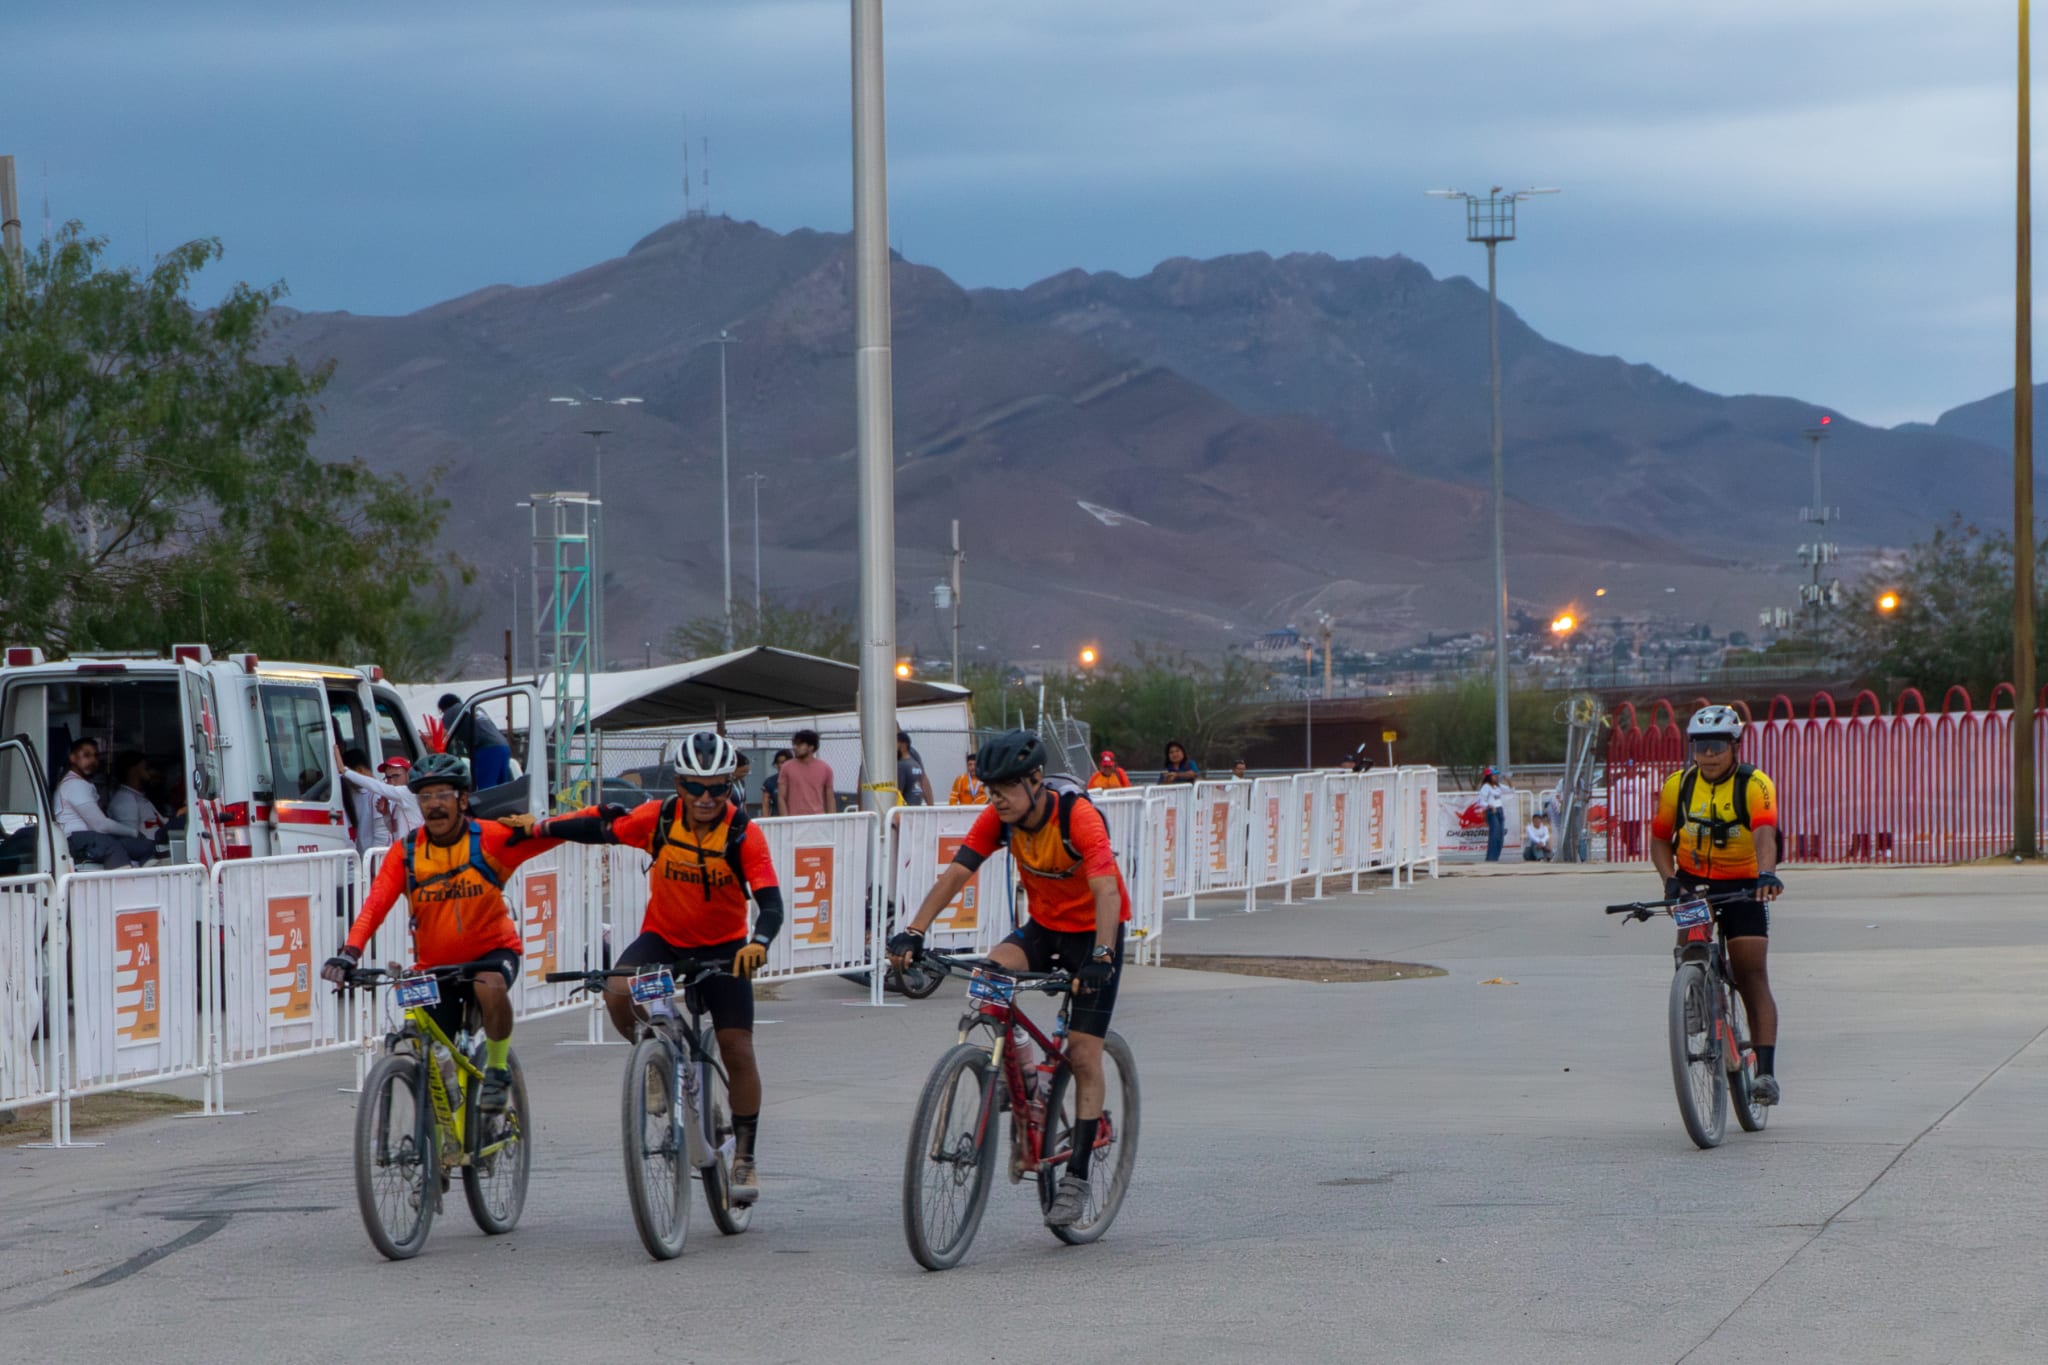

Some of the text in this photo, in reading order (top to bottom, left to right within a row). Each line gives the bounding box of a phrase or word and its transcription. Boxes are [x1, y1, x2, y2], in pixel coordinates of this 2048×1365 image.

[664, 860, 733, 888] Franlin
[814, 870, 826, 890] 24
[542, 898, 552, 921] 24
[290, 927, 303, 951] 24
[137, 942, 151, 967] 24
